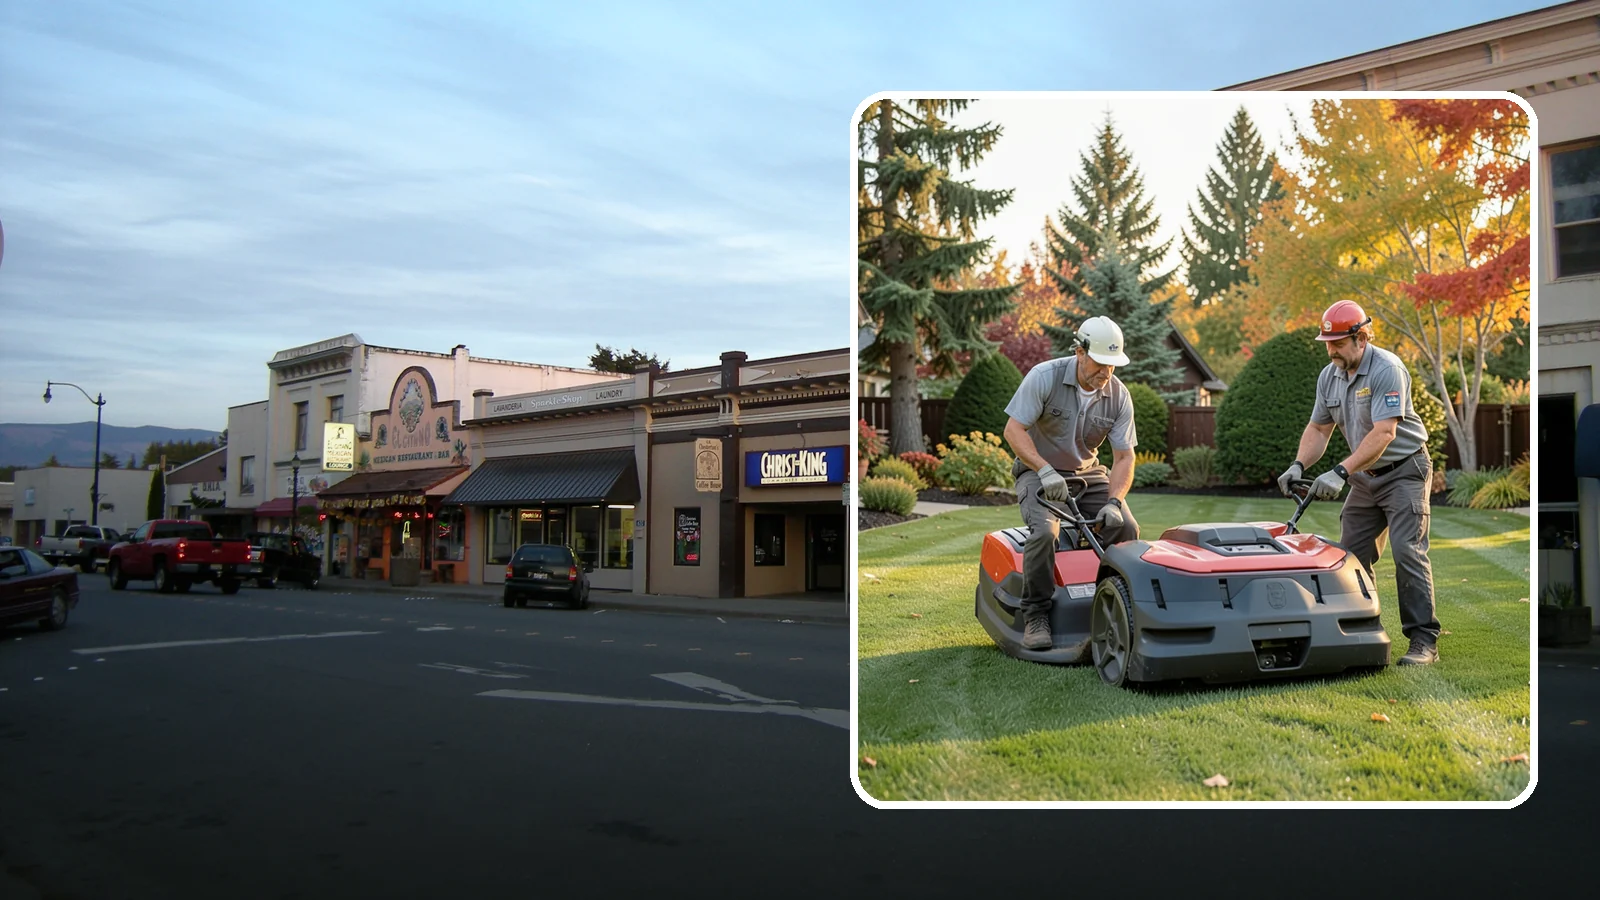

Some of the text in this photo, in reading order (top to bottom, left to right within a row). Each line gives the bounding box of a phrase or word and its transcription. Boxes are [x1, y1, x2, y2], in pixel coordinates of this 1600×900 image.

[494, 389, 623, 412] LAVANDERIA Sparkle Shop LAUNDRY
[374, 454, 397, 465] MEXICAN
[398, 451, 434, 463] RESTAURANT
[438, 450, 450, 459] BAR
[761, 450, 827, 478] CHRIST KING
